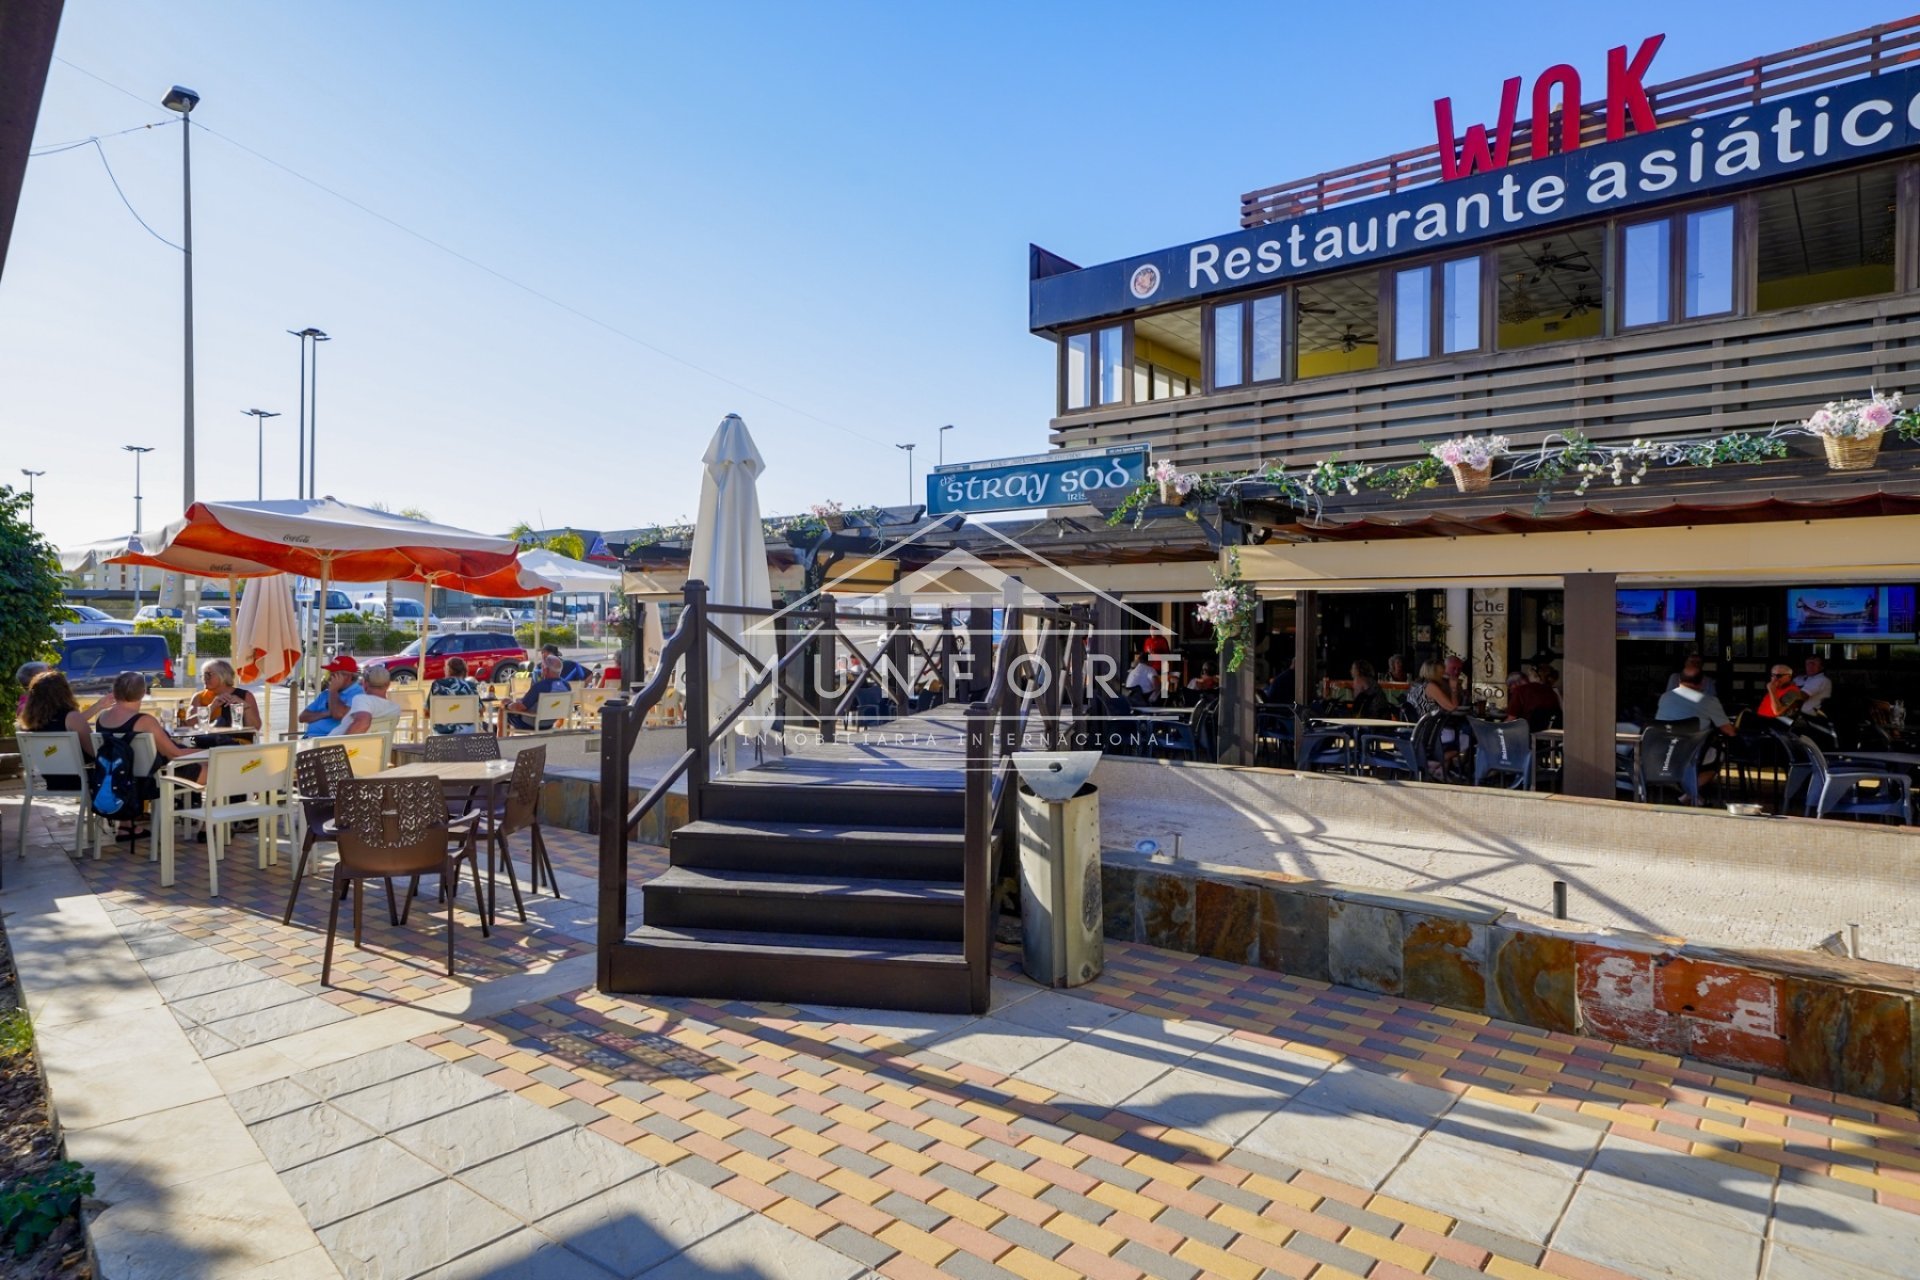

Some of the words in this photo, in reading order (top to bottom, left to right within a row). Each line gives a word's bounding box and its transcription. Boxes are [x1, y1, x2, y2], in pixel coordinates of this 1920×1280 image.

[1188, 171, 1565, 290] Restaurante
[1586, 90, 1920, 204] asiátic
[1434, 33, 1666, 181] WOK
